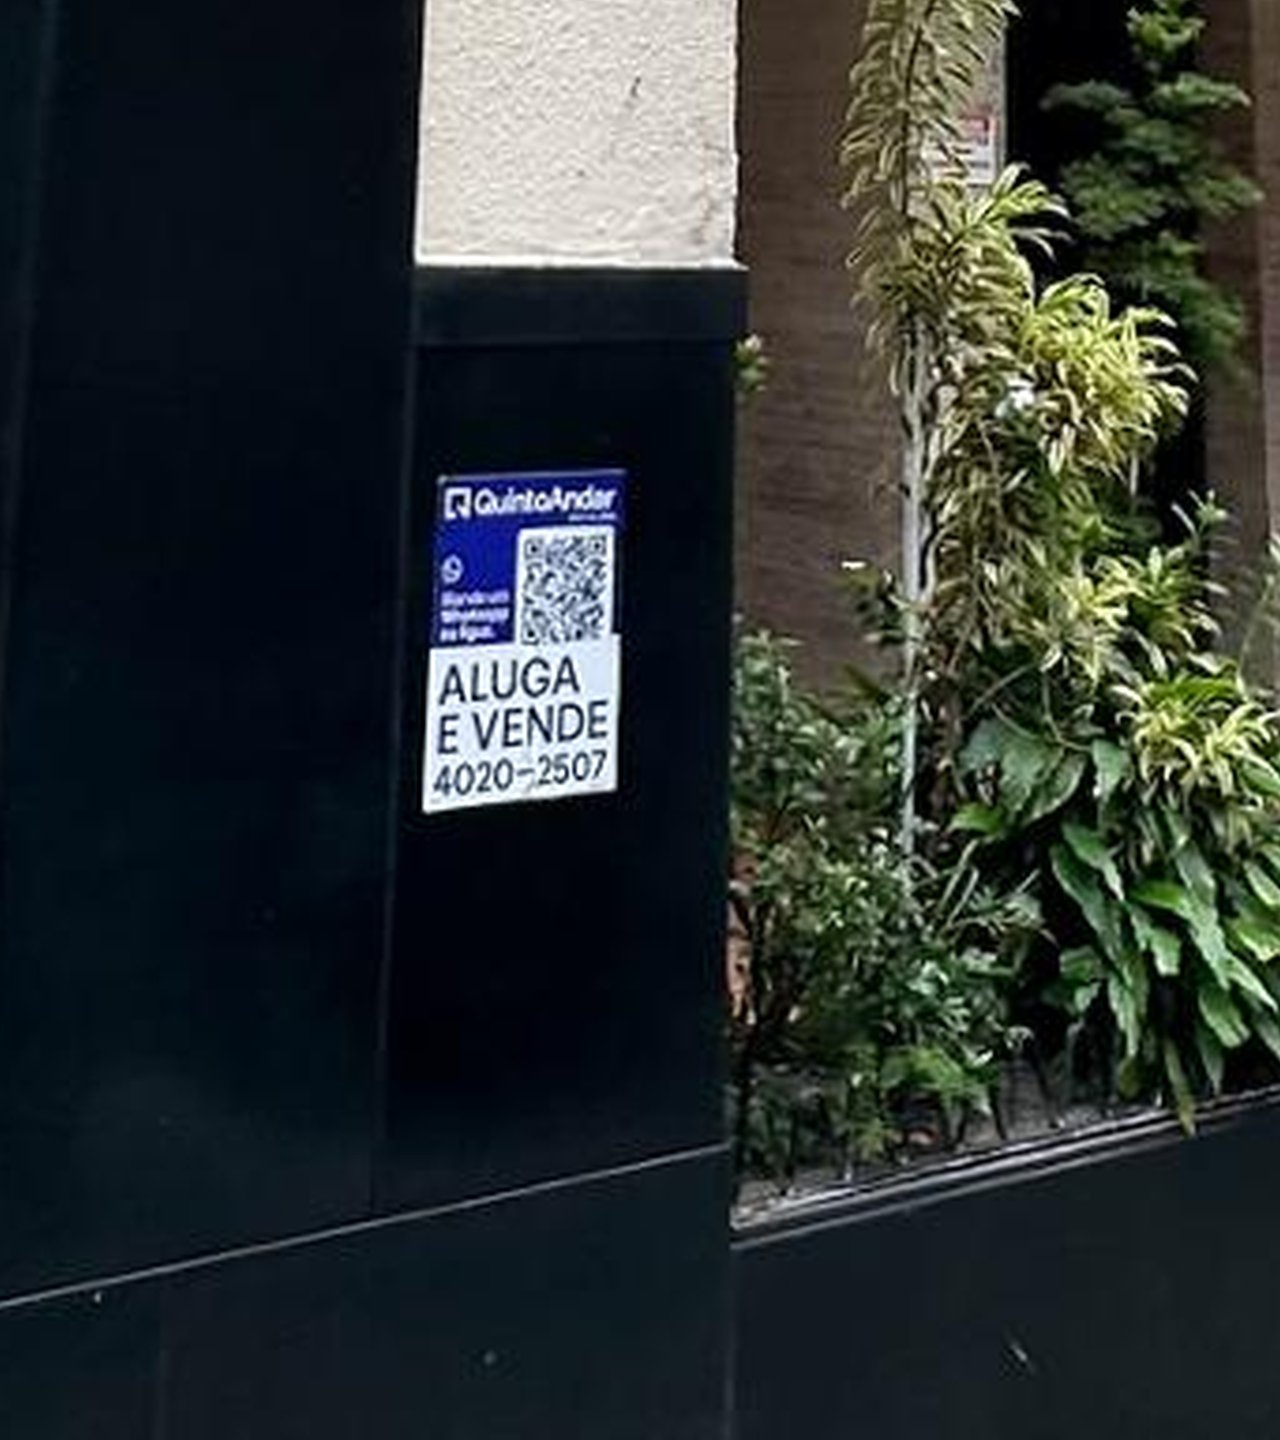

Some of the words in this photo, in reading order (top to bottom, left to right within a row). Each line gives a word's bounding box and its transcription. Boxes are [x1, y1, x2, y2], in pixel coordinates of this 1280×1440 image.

[475, 484, 617, 516] QuintoAndar
[438, 656, 580, 706] ALUGA
[437, 714, 459, 755] E
[472, 700, 608, 751] VENDE
[434, 749, 607, 797] 4020-2507
